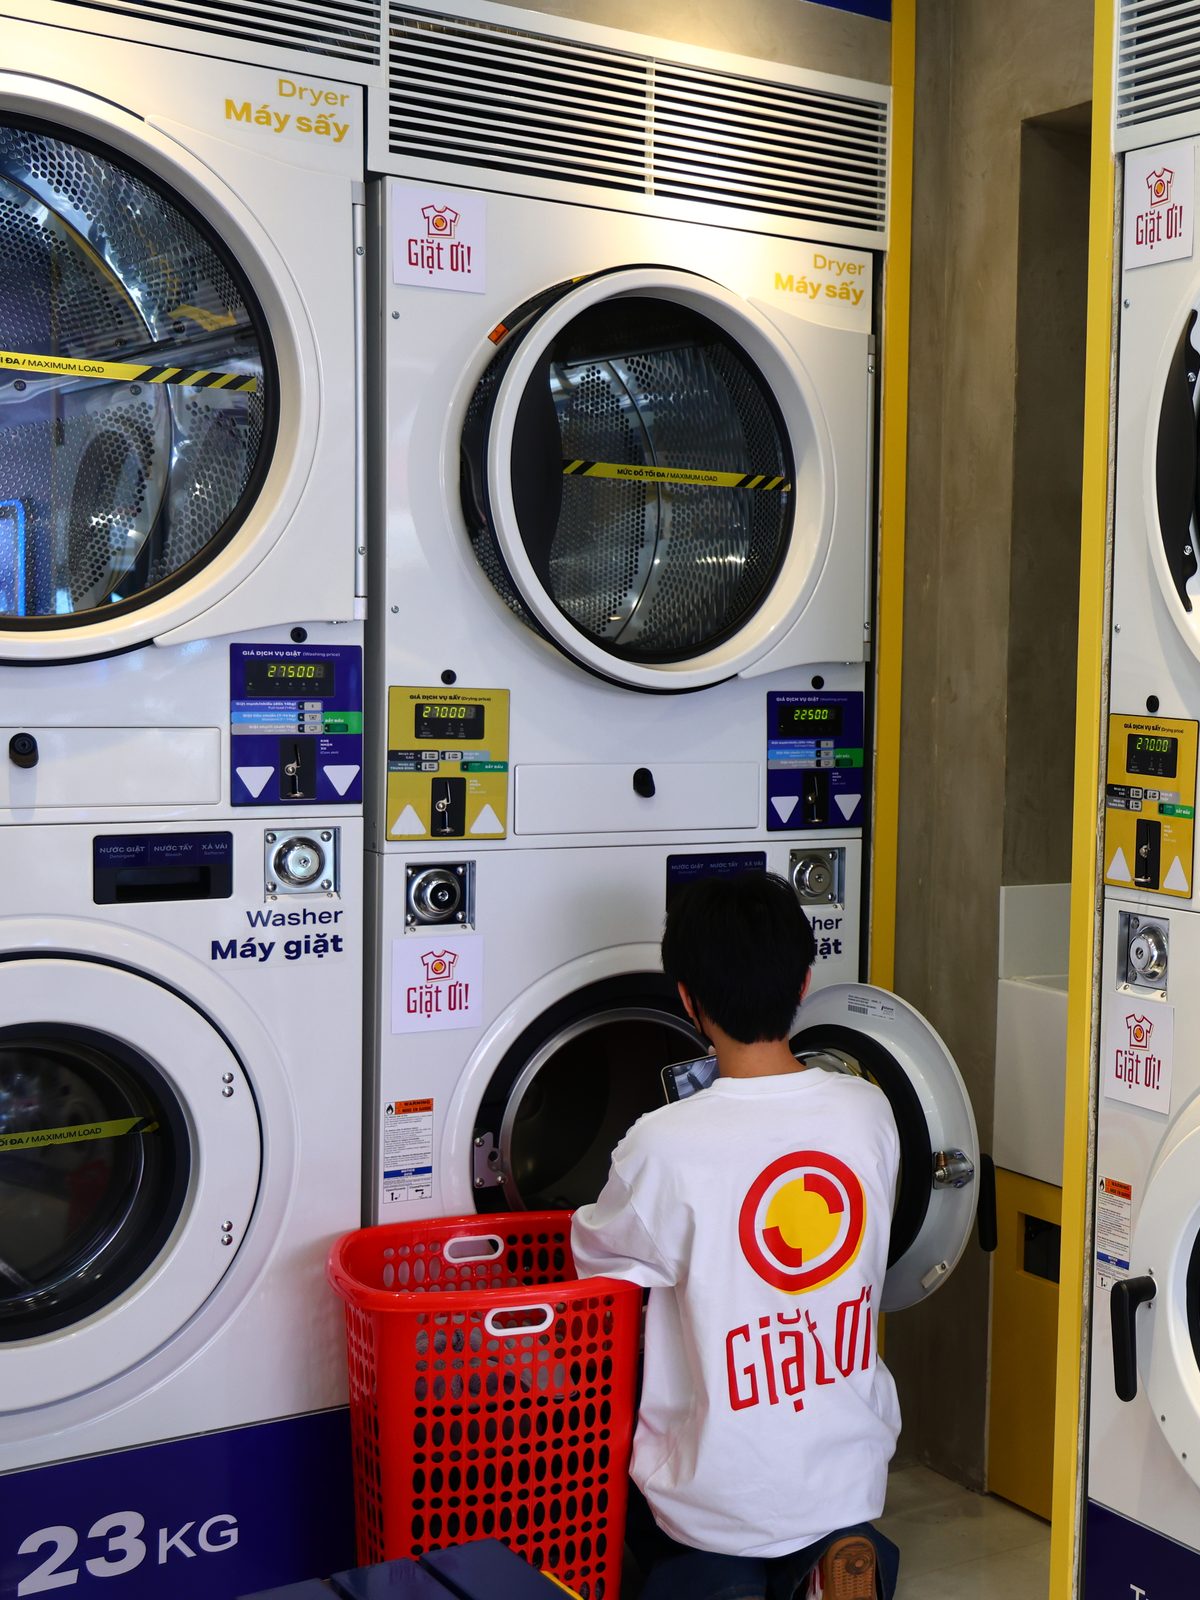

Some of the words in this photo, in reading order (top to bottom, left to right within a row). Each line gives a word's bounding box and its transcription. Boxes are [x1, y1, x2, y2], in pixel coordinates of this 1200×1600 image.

[278, 78, 350, 107] Dryer
[225, 98, 291, 133] Máy
[296, 113, 350, 143] sấy
[1135, 209, 1162, 250] Giặt
[408, 238, 444, 275] Giặt
[813, 254, 865, 277] Dryer
[774, 271, 822, 300] Máy
[825, 281, 865, 306] sấy
[5, 357, 20, 365] ĐA
[28, 360, 77, 371] MAXIMUM
[78, 365, 105, 374] LOAD
[670, 472, 701, 481] MAXIMUM
[267, 665, 315, 678] 27500
[422, 706, 466, 719] 27000
[794, 709, 828, 720] 22500
[1136, 737, 1169, 753] 27000
[246, 908, 343, 928] Washer
[812, 916, 843, 931] her
[211, 937, 276, 962] Máy
[284, 933, 343, 960] giặt
[814, 937, 843, 960] iặt
[406, 983, 442, 1019] Giặt
[1115, 1049, 1141, 1089] Giặt
[9, 1138, 24, 1146] ĐA
[31, 1130, 77, 1143] MAXIMUM
[78, 1127, 102, 1136] LOAD
[726, 1307, 835, 1413] Giặt
[17, 1510, 147, 1598] 23
[158, 1513, 239, 1565] KG
